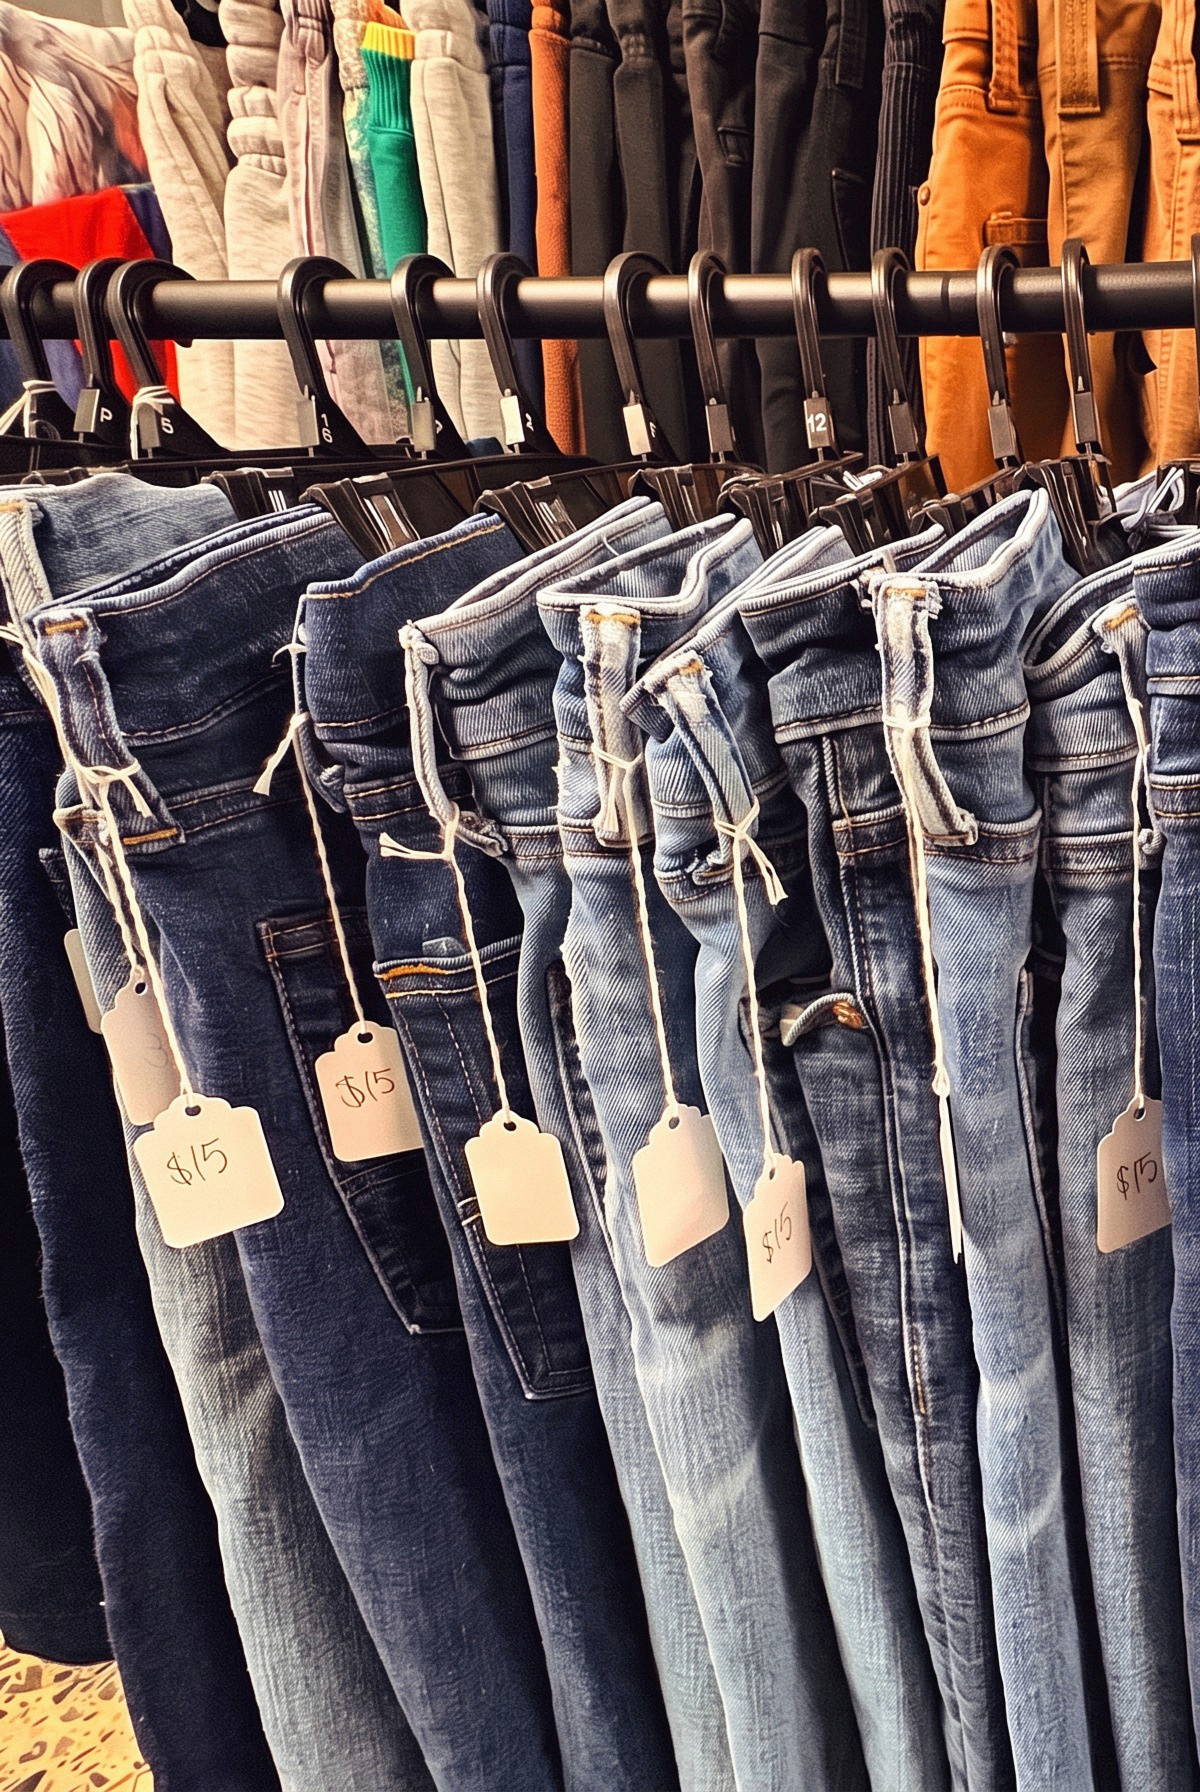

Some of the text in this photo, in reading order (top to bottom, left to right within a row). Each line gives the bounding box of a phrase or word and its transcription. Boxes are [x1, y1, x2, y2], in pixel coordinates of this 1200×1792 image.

[100, 407, 113, 423] P
[160, 417, 174, 434] 5
[807, 412, 827, 433] 12
[336, 1067, 395, 1108] $15
[167, 1137, 228, 1186] $15
[1117, 1151, 1158, 1201] $15
[762, 1201, 792, 1264] $15
